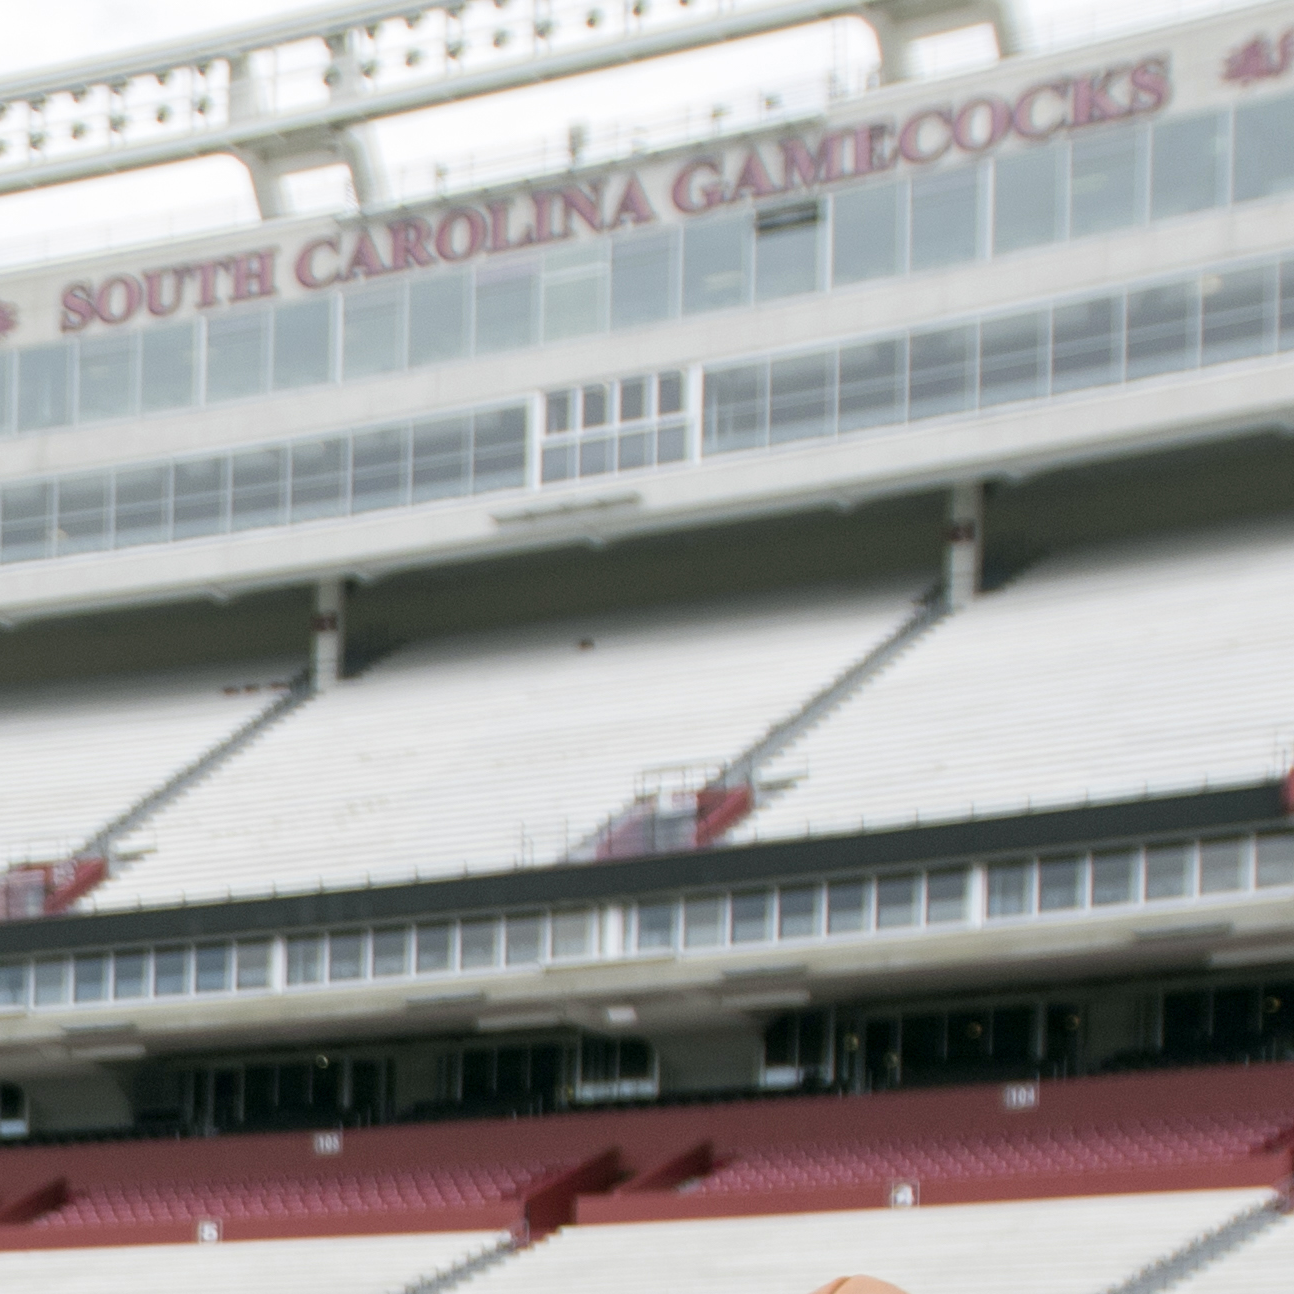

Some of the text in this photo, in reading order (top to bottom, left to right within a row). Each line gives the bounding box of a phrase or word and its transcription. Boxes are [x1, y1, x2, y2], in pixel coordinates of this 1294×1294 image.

[59, 52, 1171, 333] SOUTH CAROLINA GAMECOCKS
